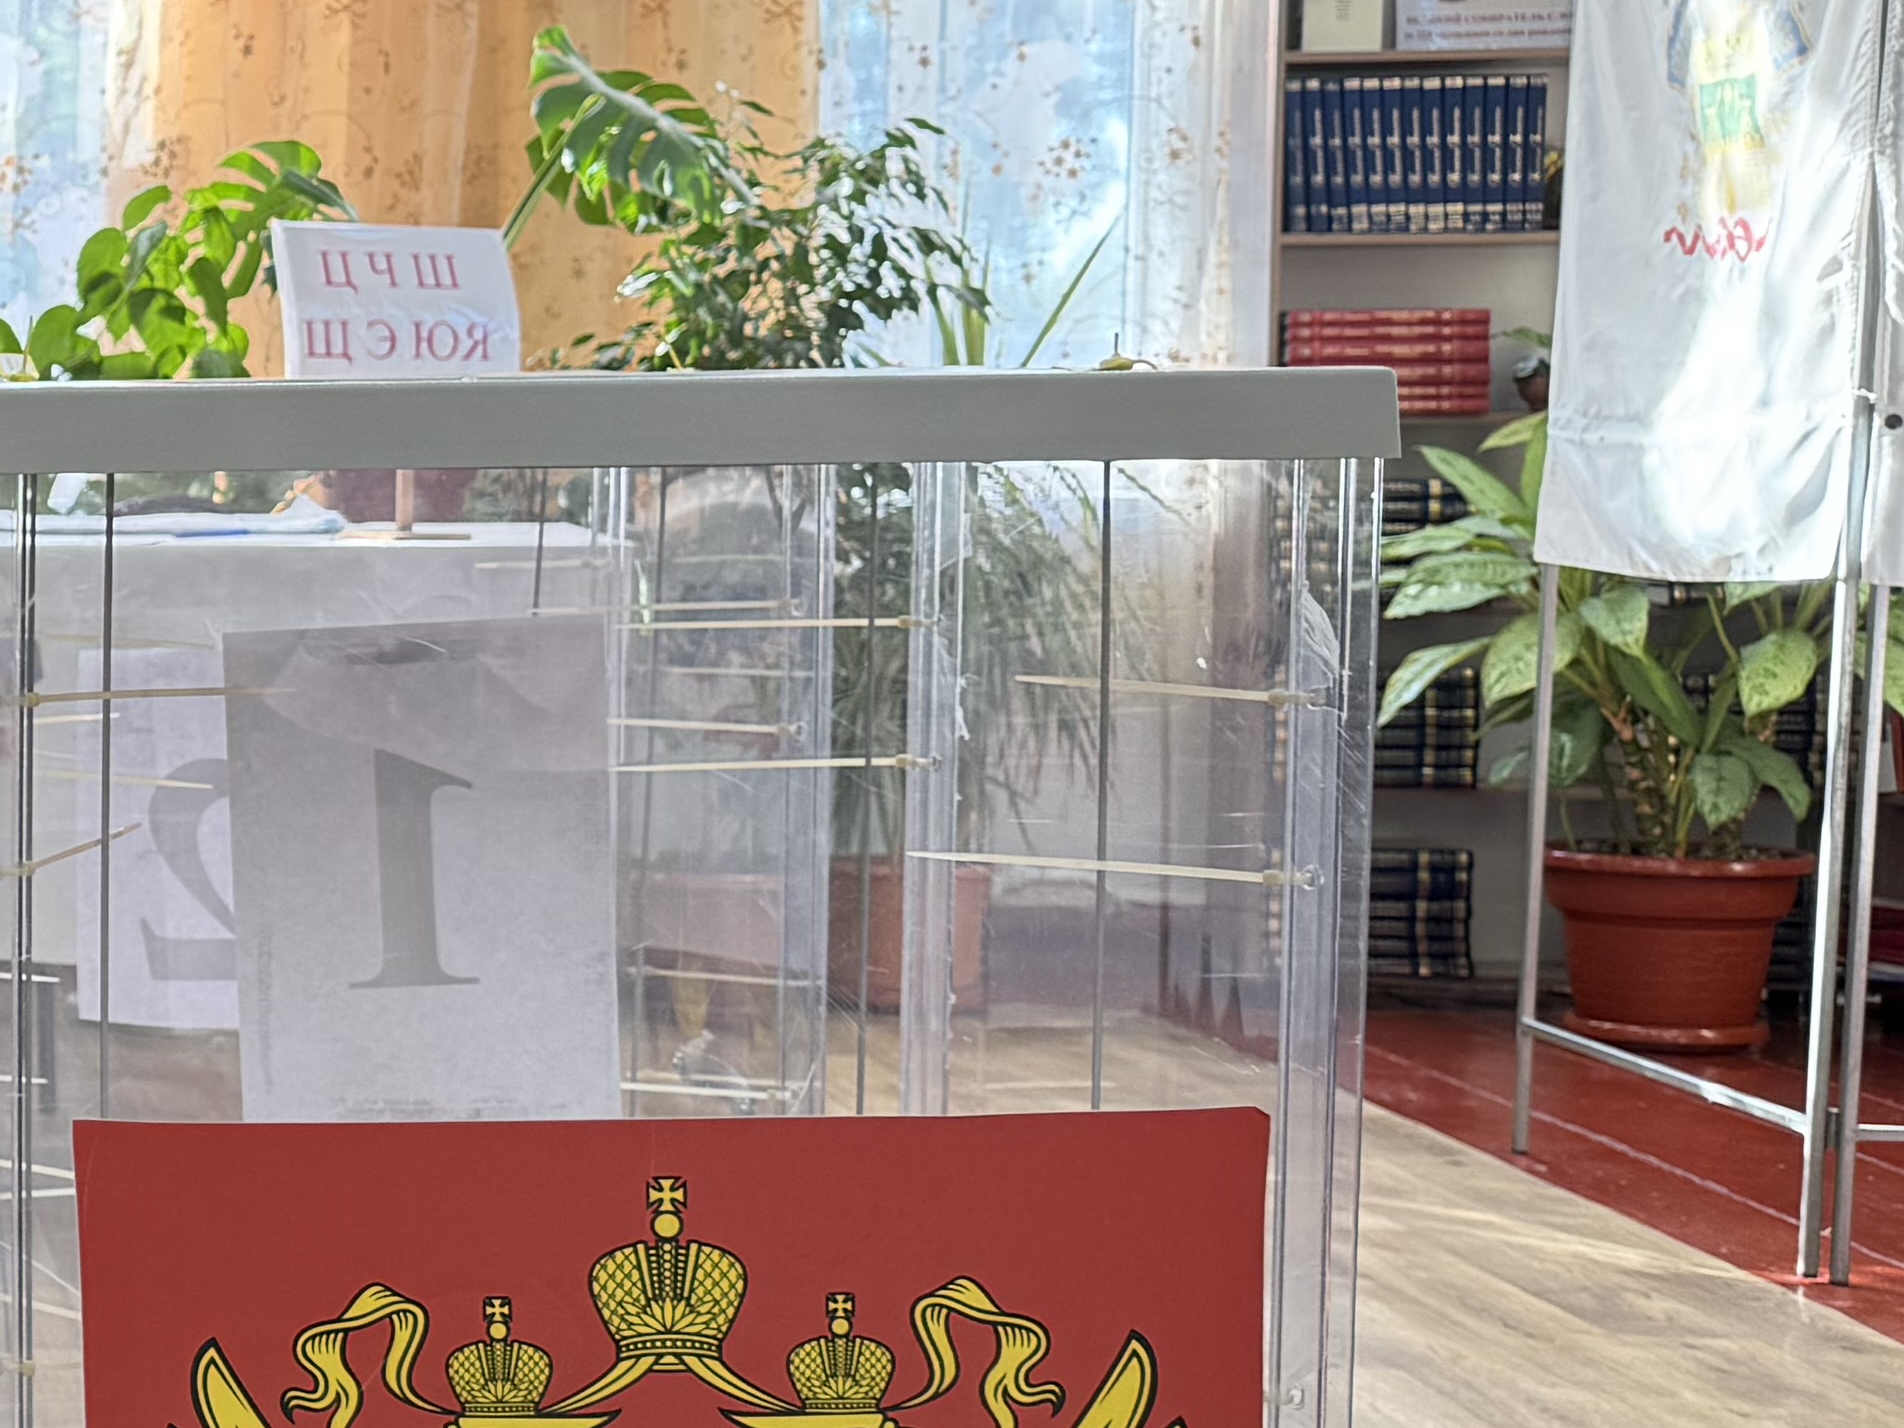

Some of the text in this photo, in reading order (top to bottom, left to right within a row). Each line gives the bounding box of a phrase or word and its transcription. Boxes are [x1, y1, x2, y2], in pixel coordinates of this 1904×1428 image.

[319, 250, 460, 294] Ц Ч Ш
[305, 319, 353, 364] Щ
[366, 319, 397, 361] Э
